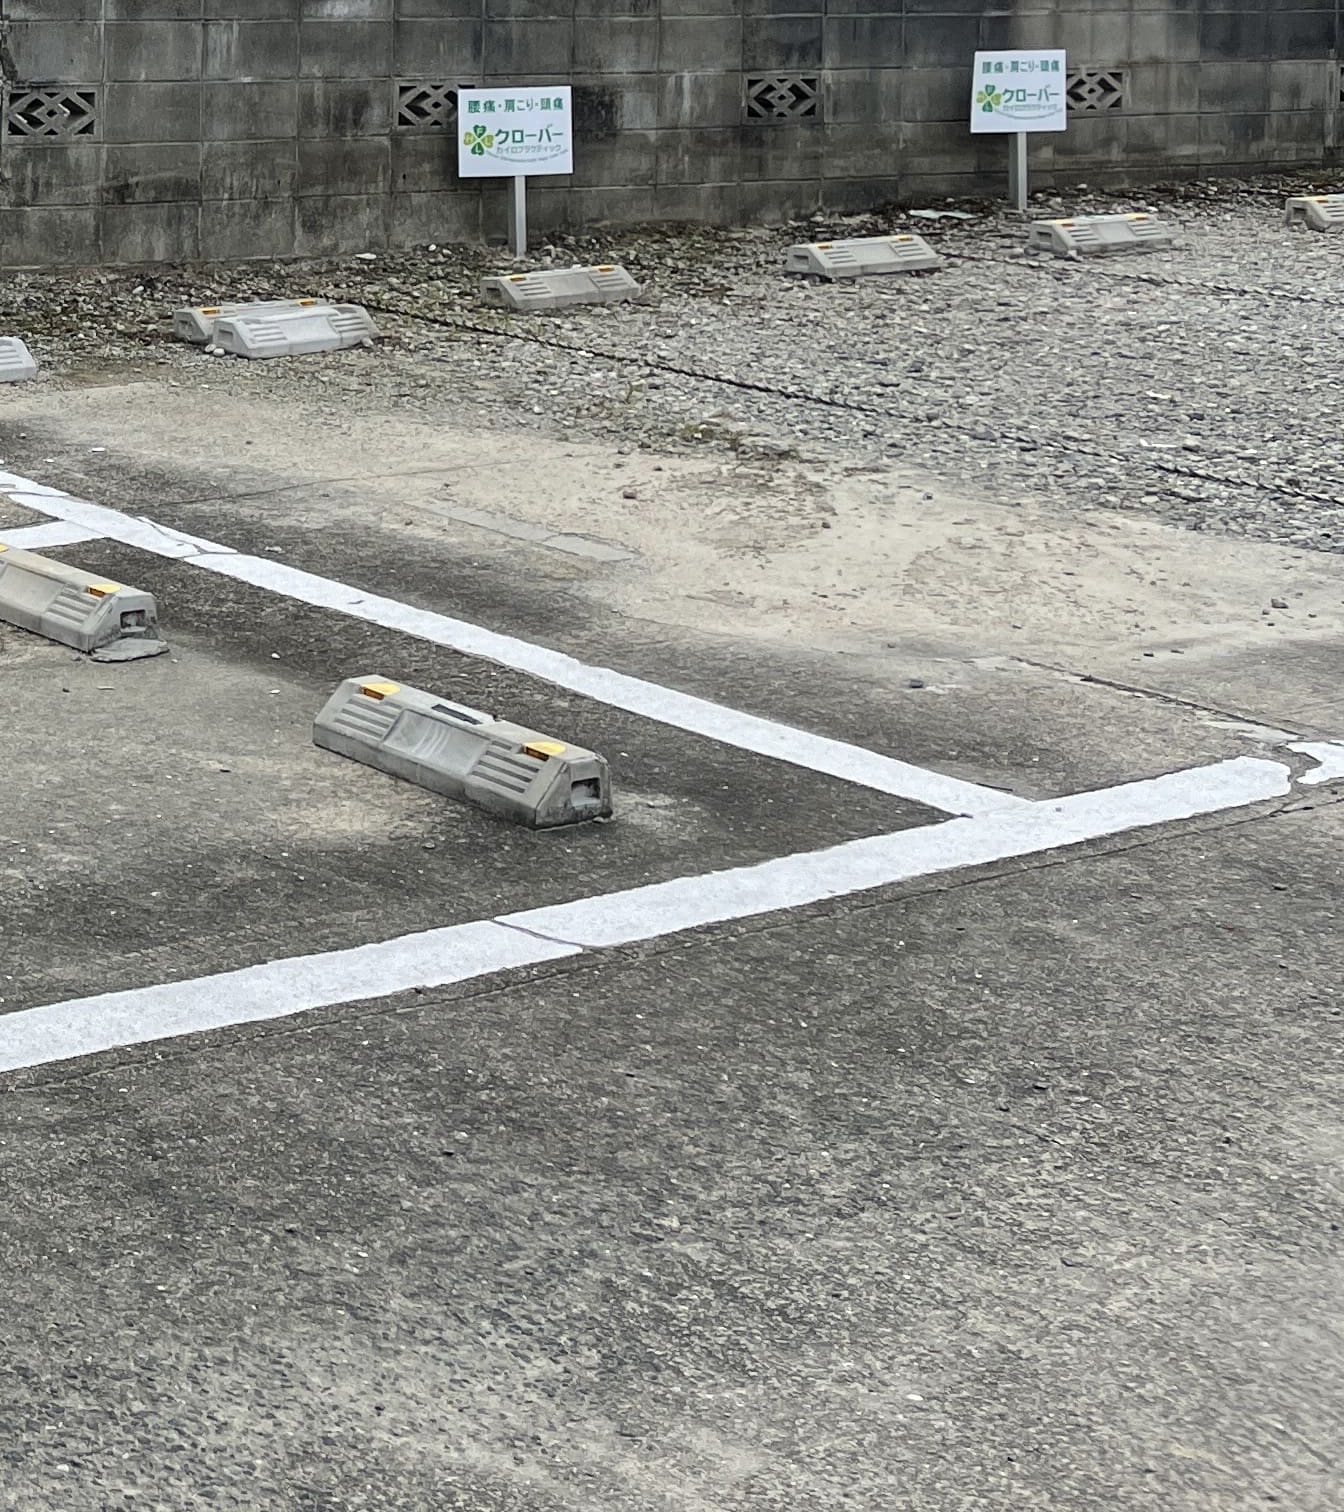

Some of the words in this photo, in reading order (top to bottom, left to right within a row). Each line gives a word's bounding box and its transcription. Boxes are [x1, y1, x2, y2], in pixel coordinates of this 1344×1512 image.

[1002, 84, 1060, 103] クローバー
[494, 123, 564, 145] クローバー
